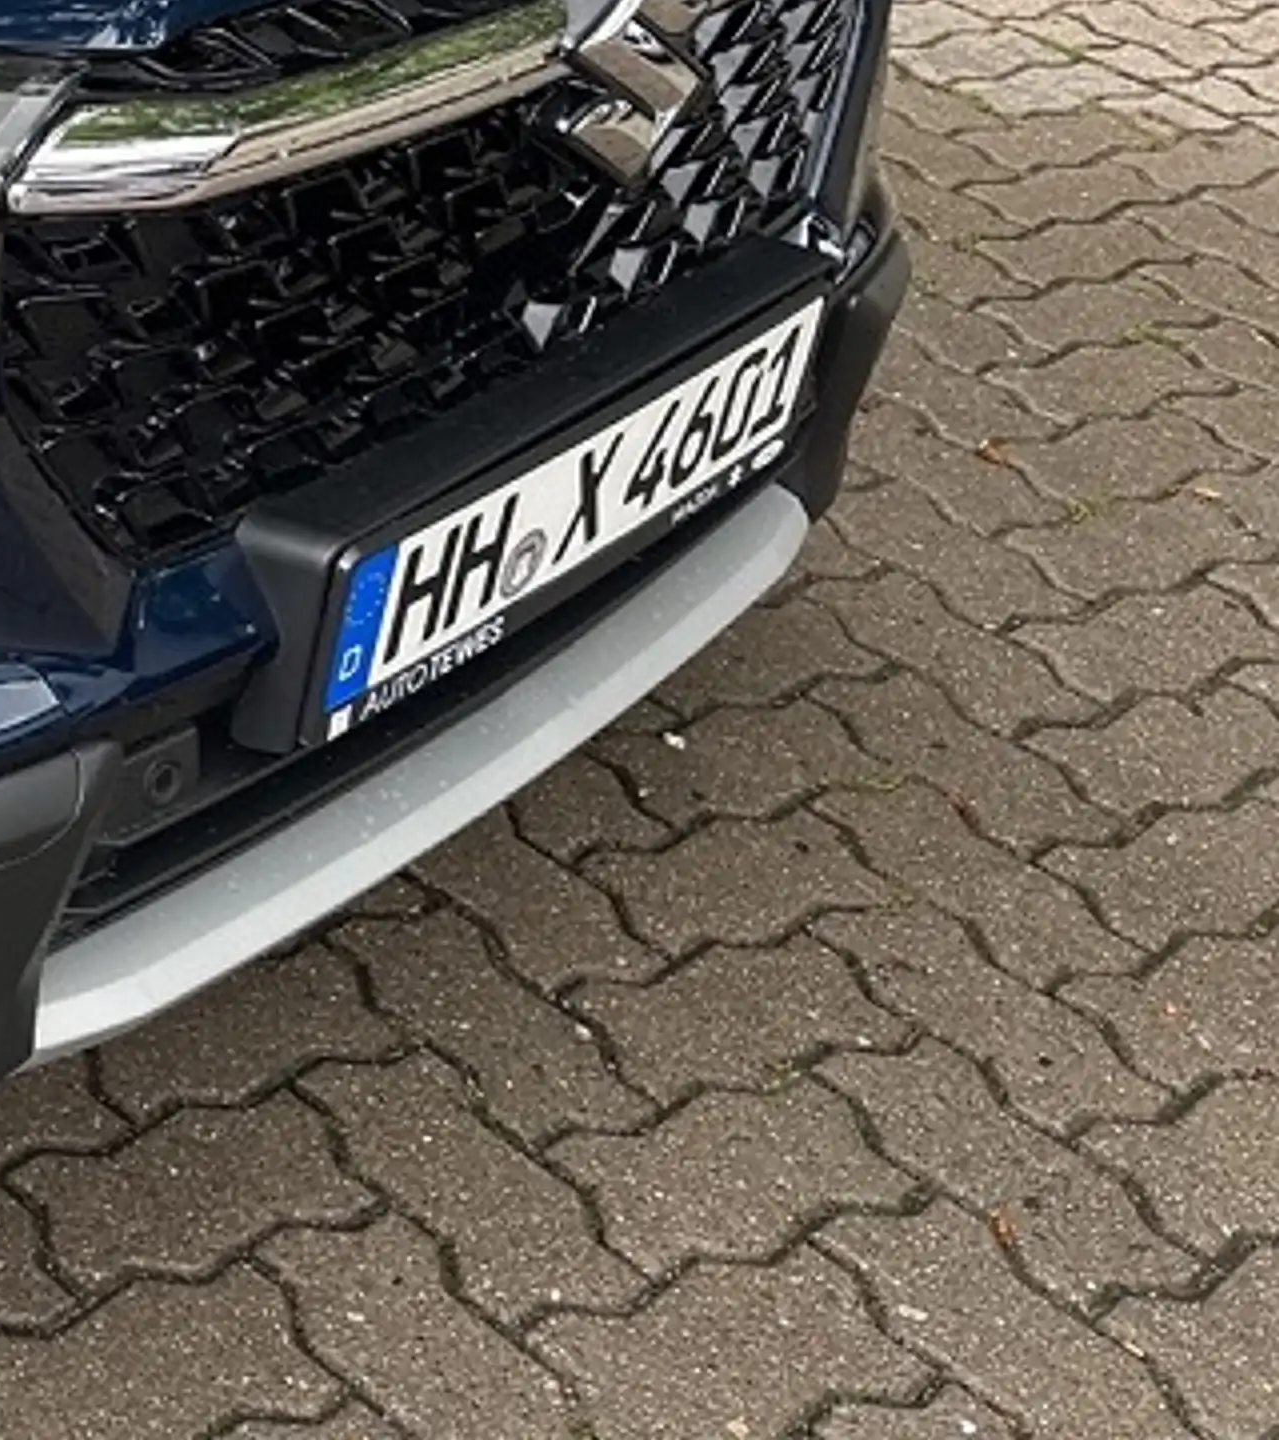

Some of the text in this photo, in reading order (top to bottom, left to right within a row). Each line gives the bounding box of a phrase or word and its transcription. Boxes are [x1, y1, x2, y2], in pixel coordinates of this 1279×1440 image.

[386, 325, 803, 663] HH X 4601
[338, 643, 363, 682] D
